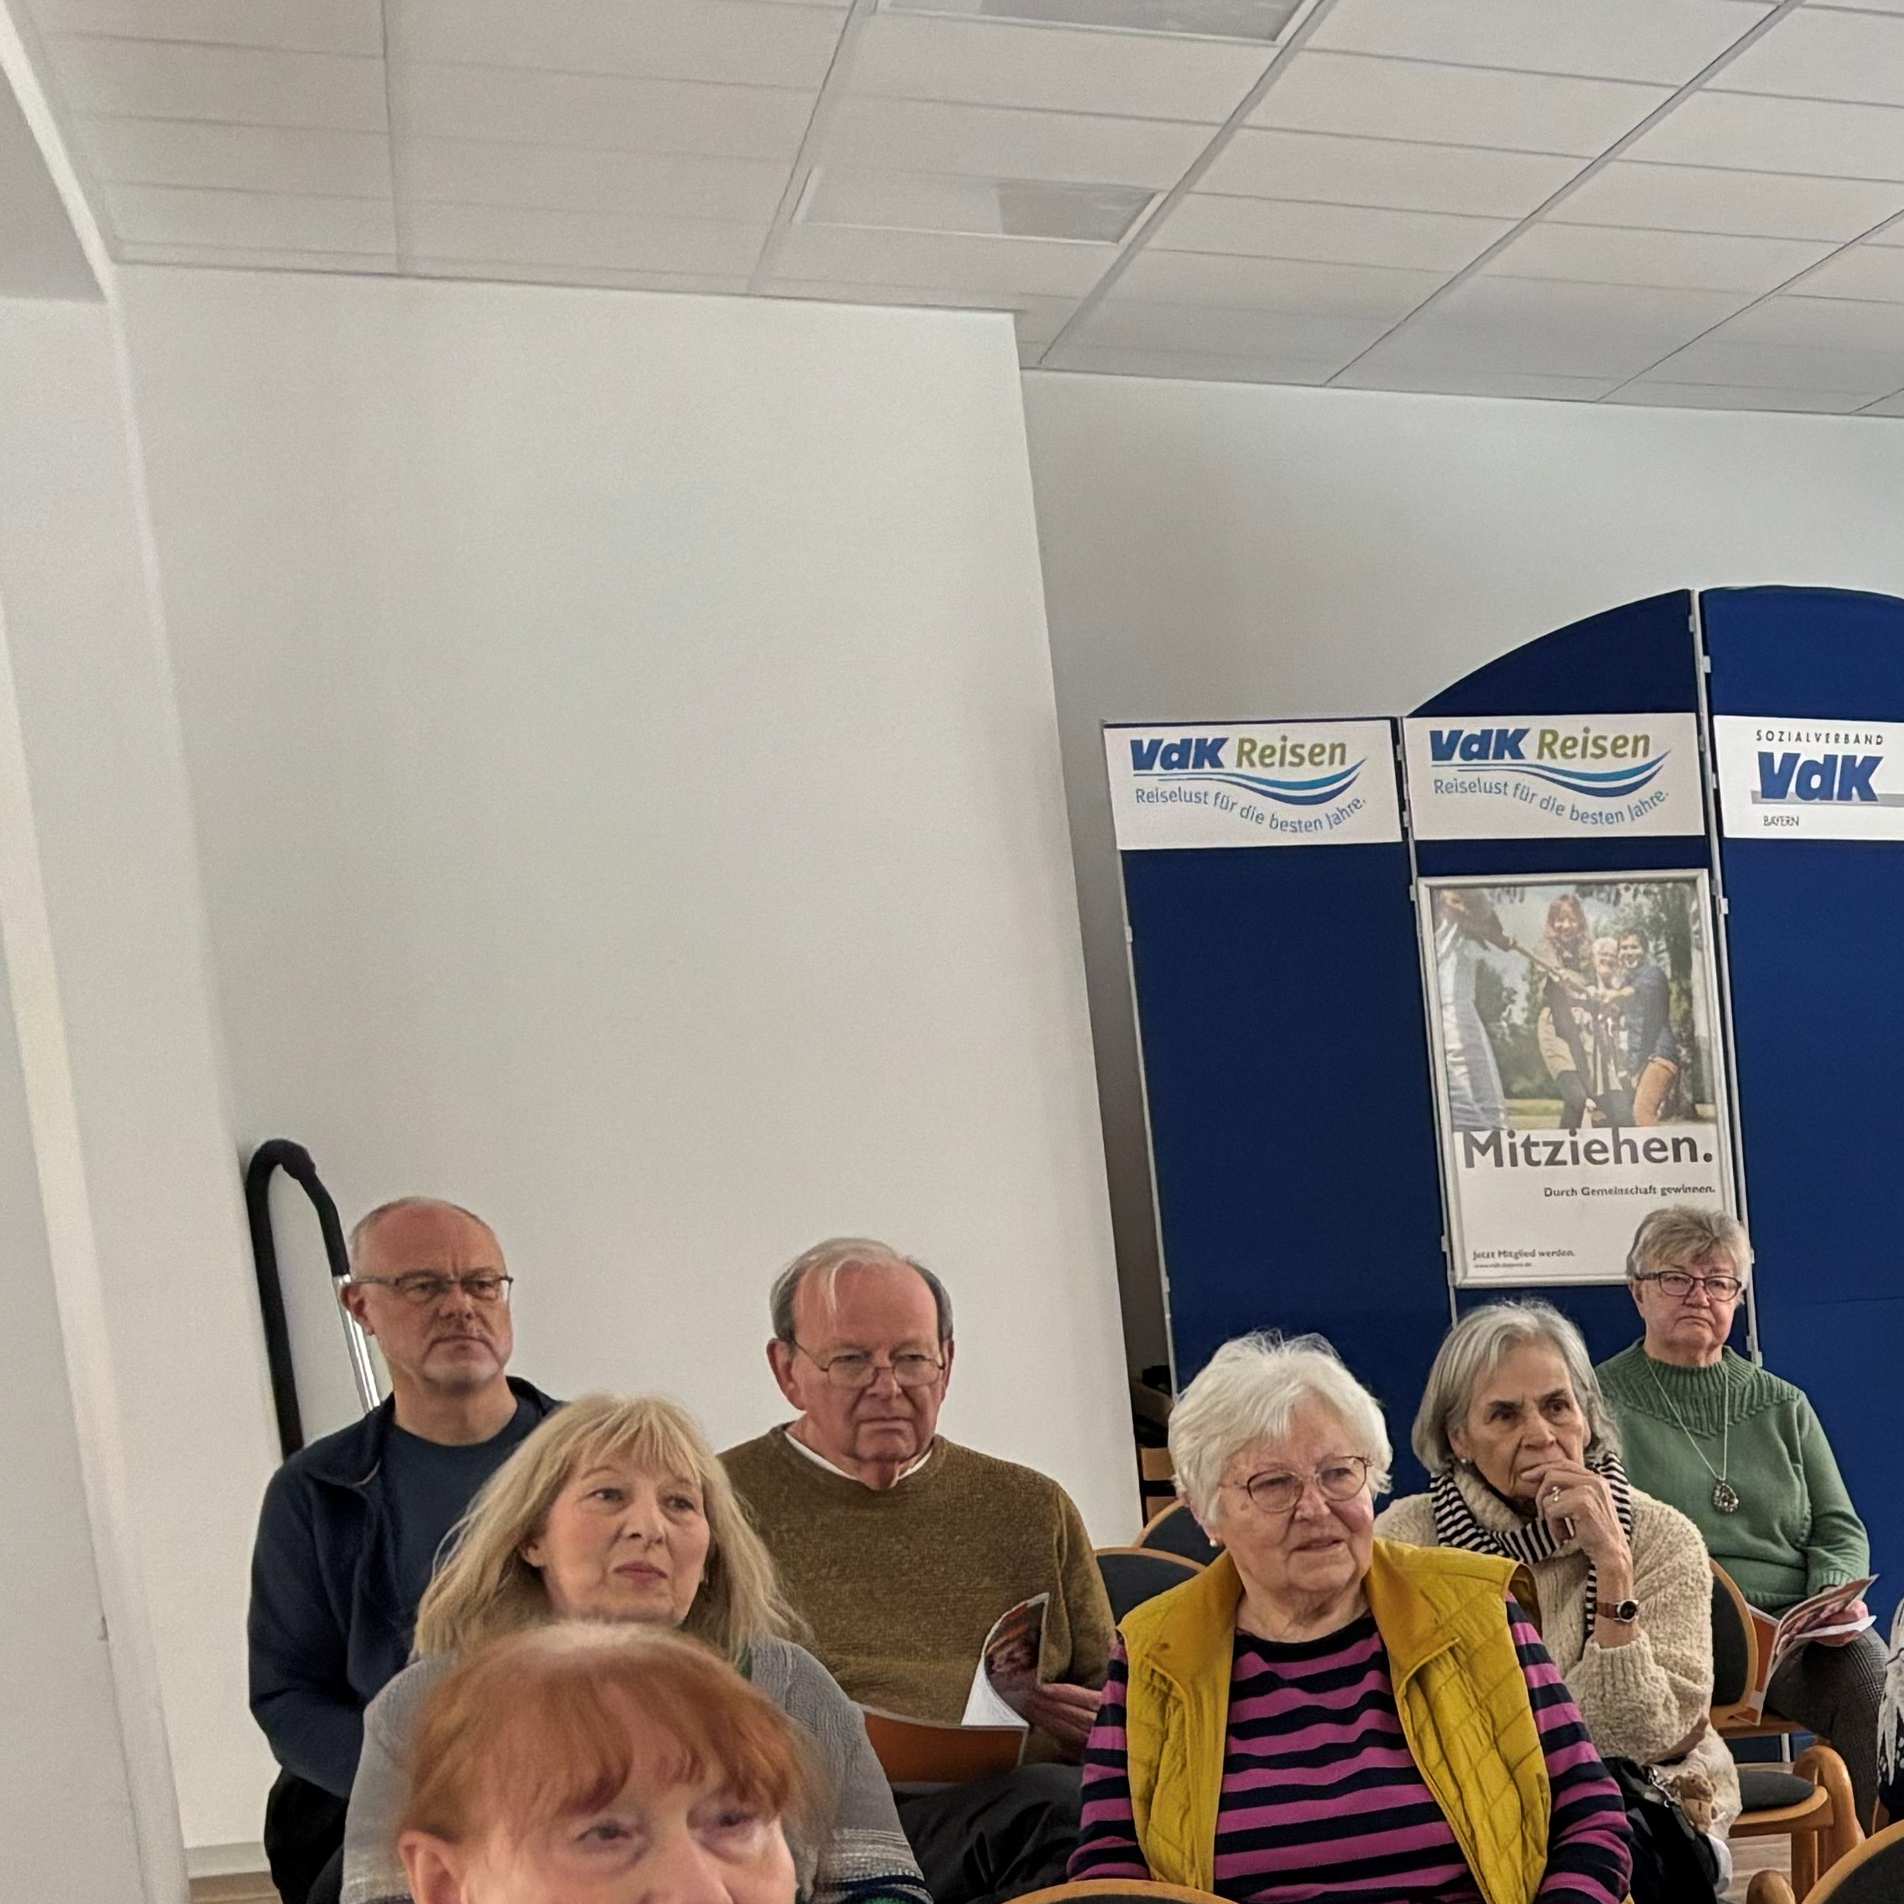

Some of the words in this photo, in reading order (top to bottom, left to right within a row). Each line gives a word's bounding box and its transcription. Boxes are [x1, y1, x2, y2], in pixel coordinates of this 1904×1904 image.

[1130, 737, 1229, 771] VdK
[1235, 735, 1347, 768] Reisen
[1429, 728, 1530, 761] VdK
[1537, 726, 1650, 760] Reisen
[1756, 729, 1884, 746] SOZIALVERBAND
[1757, 751, 1884, 802] VdK
[1136, 786, 1209, 805] Reiselust
[1213, 791, 1238, 813] für
[1239, 804, 1265, 825] die
[1269, 813, 1323, 833] besten
[1326, 796, 1367, 830] Jahre.
[1434, 778, 1509, 796] Reiselust
[1513, 783, 1538, 804] für
[1540, 795, 1566, 817] die
[1569, 805, 1625, 825] besten
[1628, 788, 1670, 823] Jahre.
[1763, 815, 1800, 827] BAYERN
[1462, 1126, 1714, 1169] Mitziehen.
[1544, 1186, 1578, 1198] Durch
[1581, 1185, 1657, 1197] Gemeinschaft
[1660, 1184, 1716, 1197] gewinnen.
